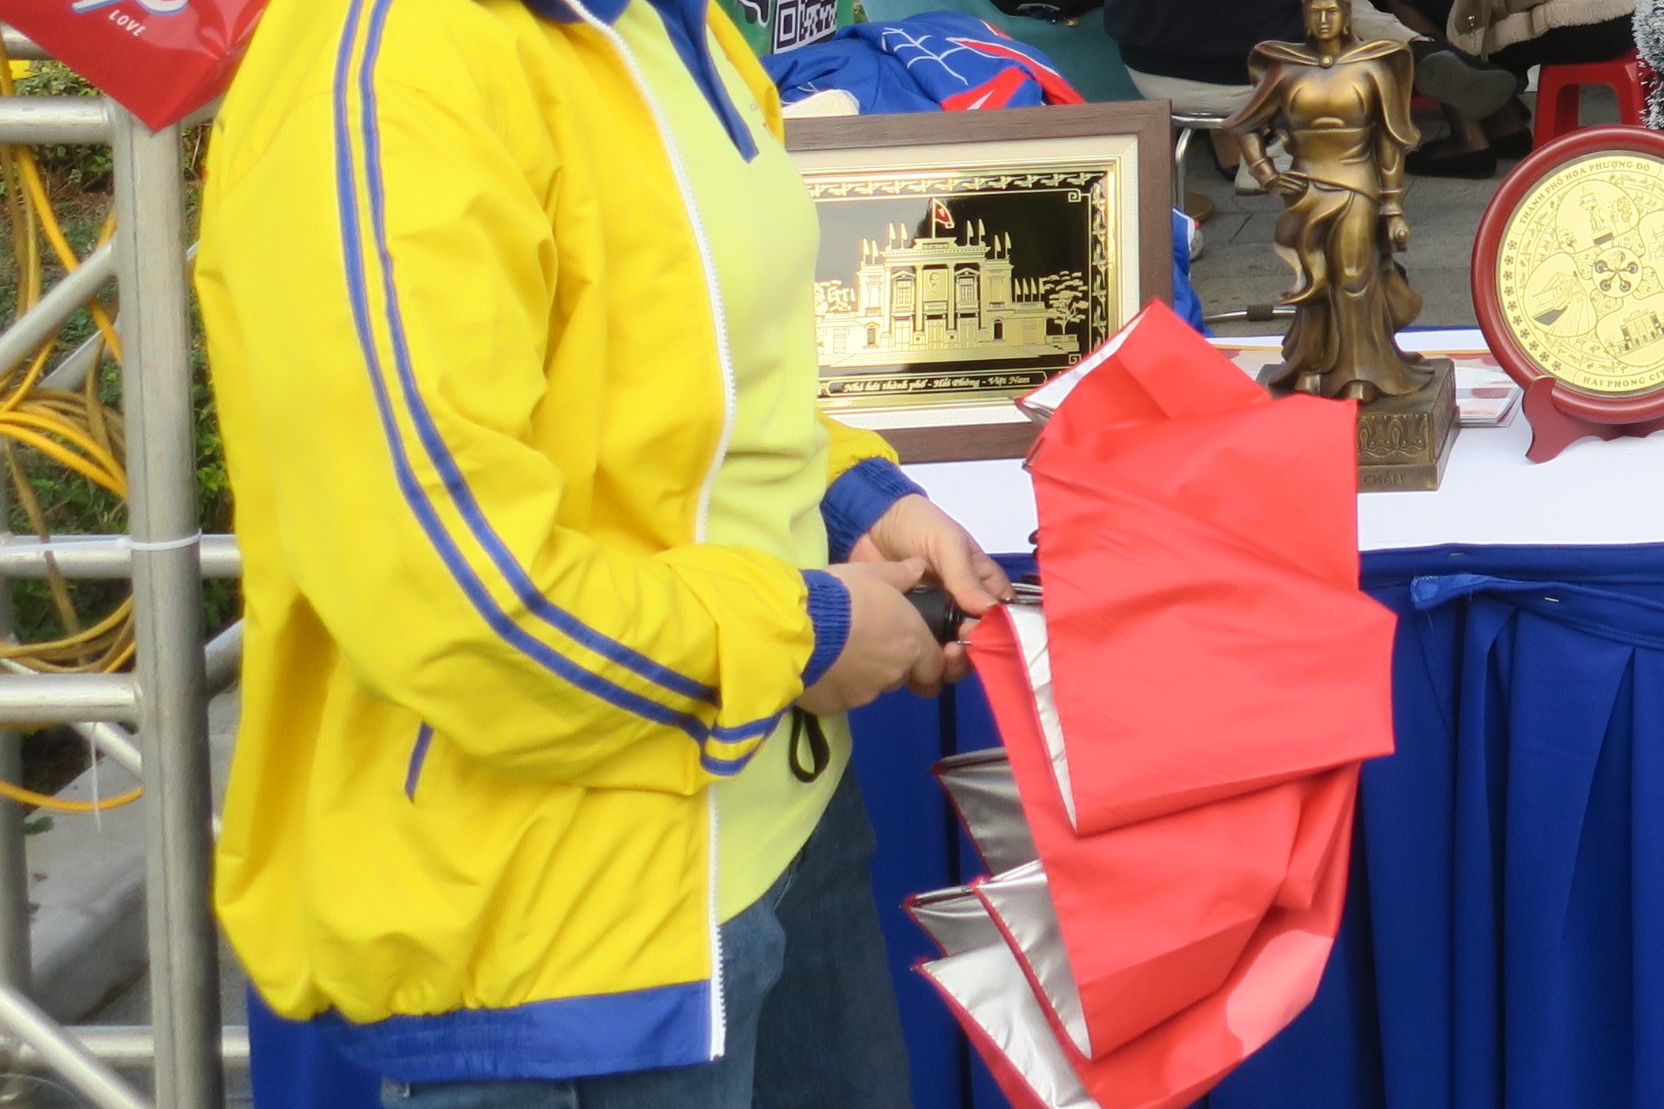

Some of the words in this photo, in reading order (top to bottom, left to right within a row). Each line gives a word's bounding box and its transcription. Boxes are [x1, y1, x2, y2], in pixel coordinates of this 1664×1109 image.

[109, 9, 147, 37] LOVE
[1565, 167, 1588, 181] HOA
[1606, 377, 1647, 389] PHONG
